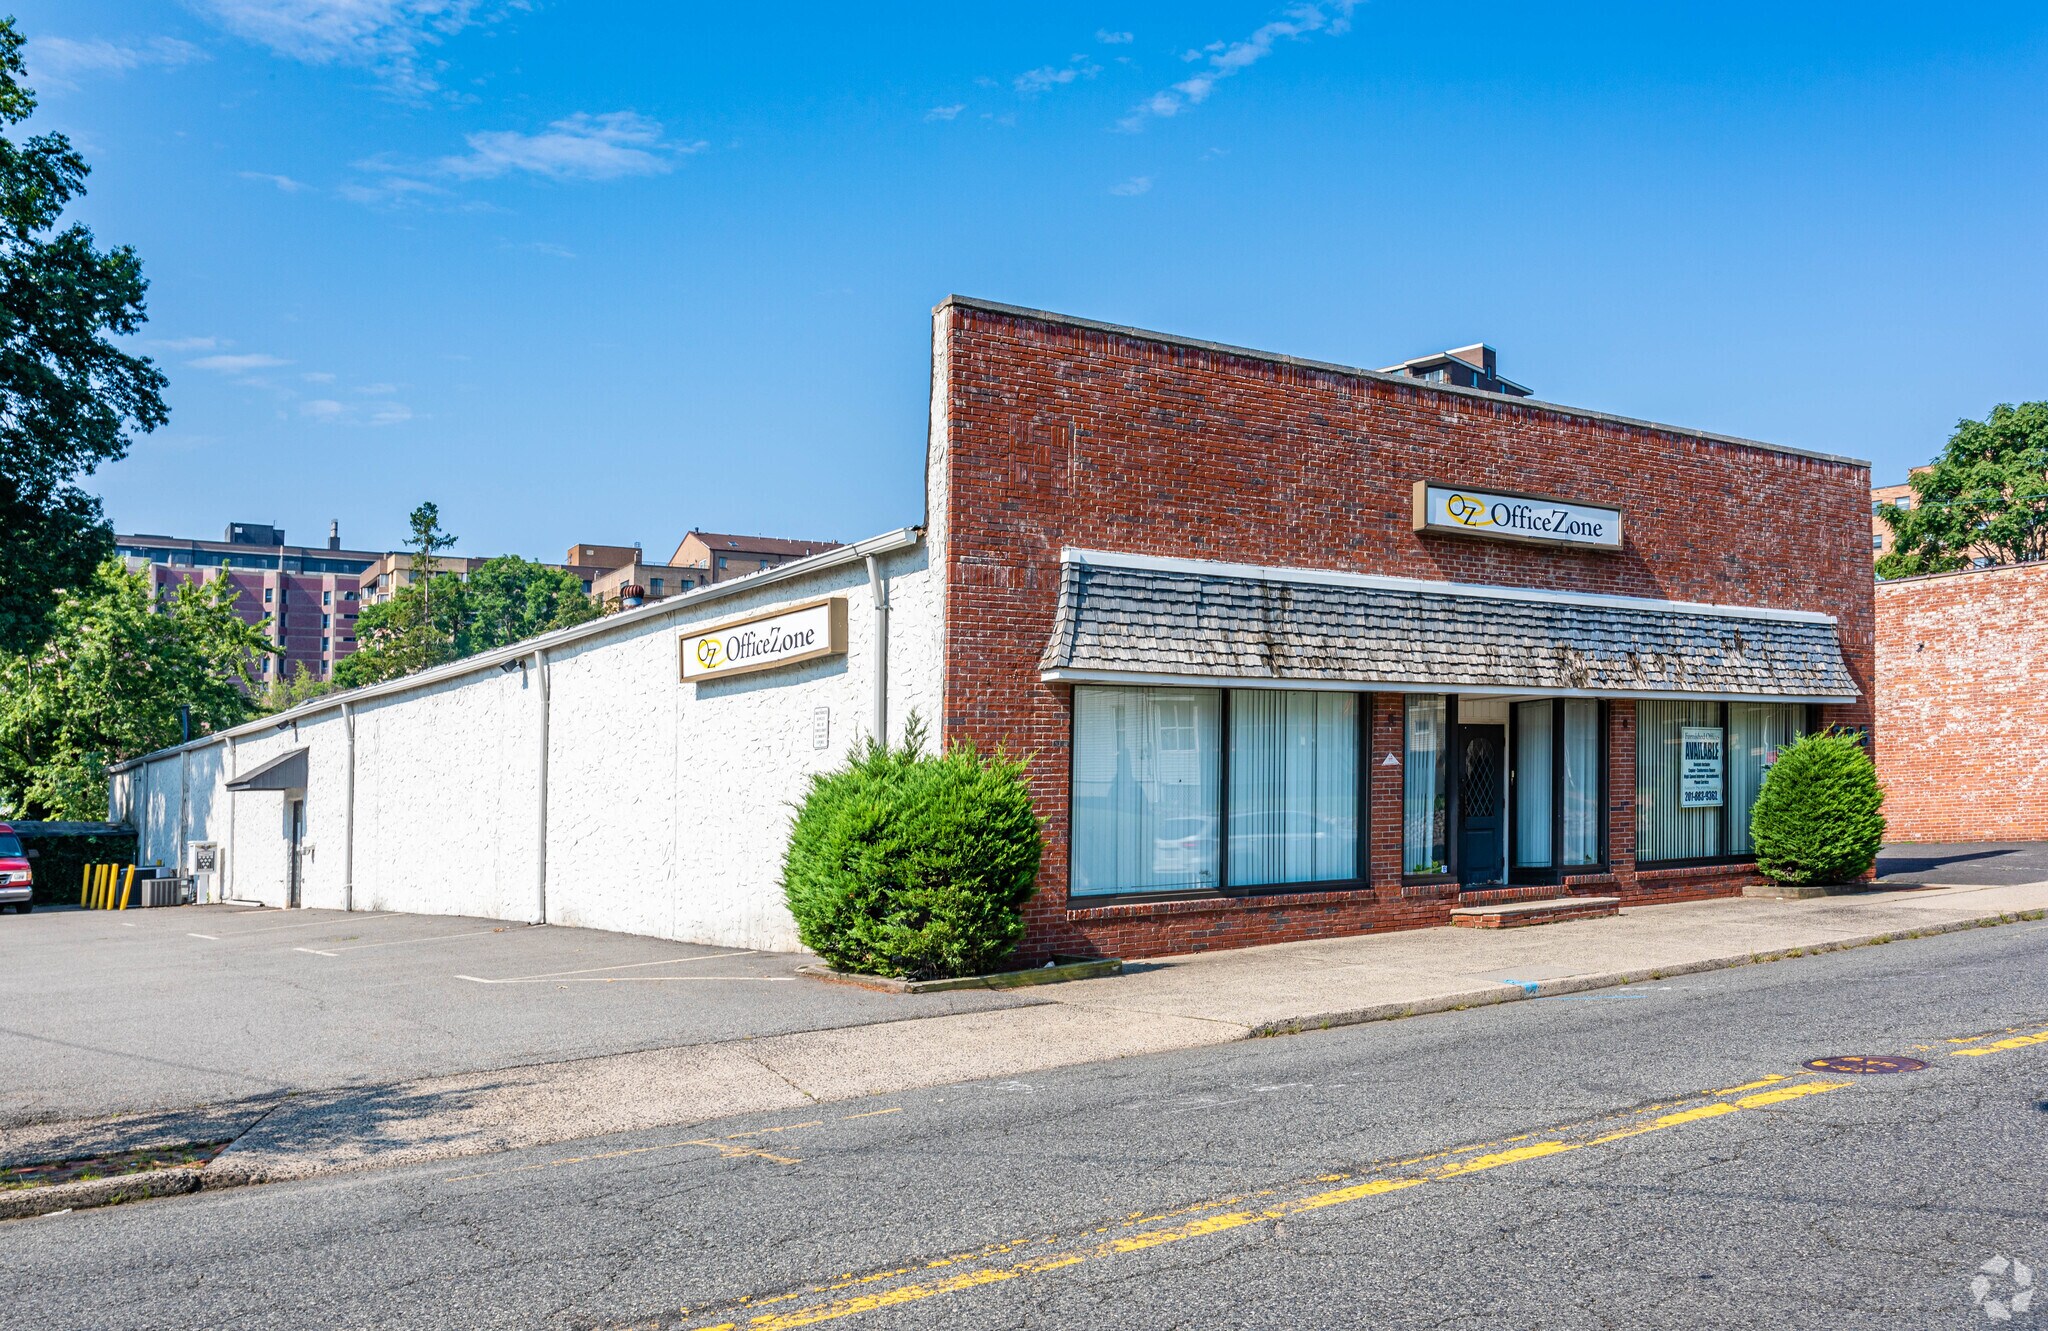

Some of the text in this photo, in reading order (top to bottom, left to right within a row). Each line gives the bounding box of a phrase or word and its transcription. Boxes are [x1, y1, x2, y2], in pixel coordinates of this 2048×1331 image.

[1491, 503, 1603, 537] OfficeZone
[726, 627, 815, 661] OfficeZone
[1685, 742, 1719, 760] AVAILABLE
